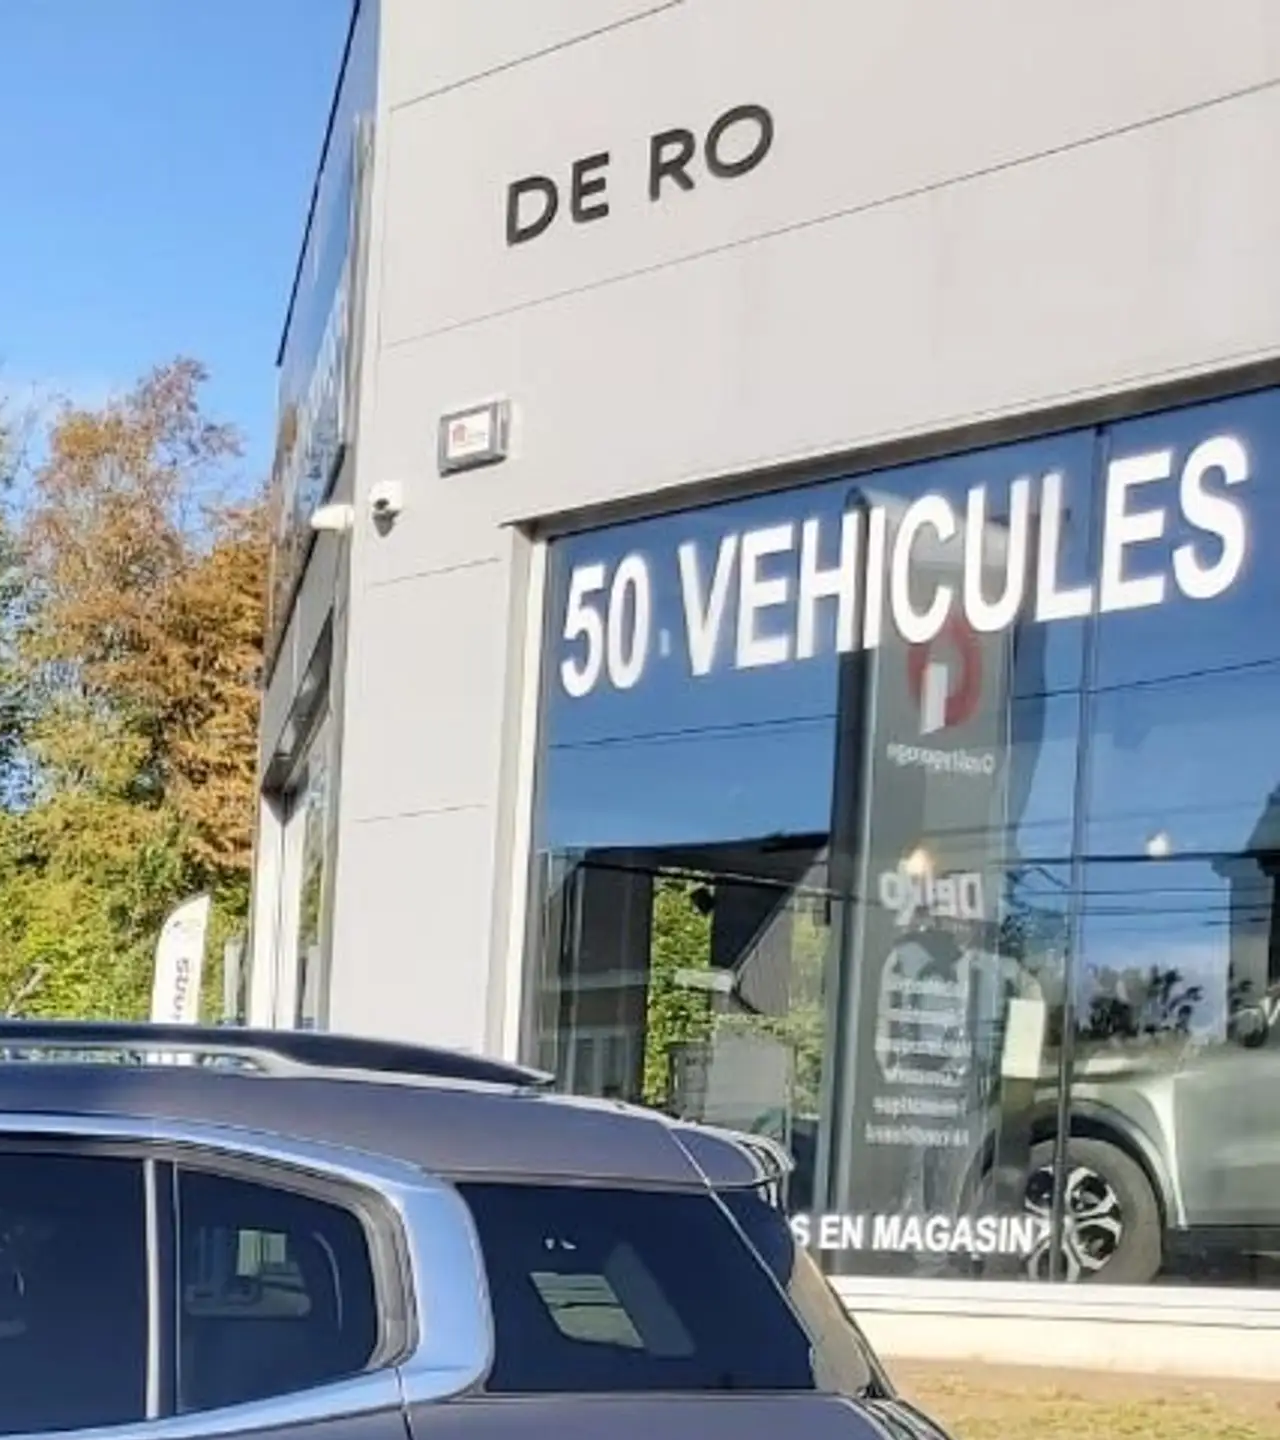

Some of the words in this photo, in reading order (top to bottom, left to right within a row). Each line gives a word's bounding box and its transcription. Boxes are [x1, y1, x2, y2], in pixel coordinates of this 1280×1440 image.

[505, 150, 610, 248] DE
[647, 102, 775, 203] RO
[560, 550, 651, 699] 50
[678, 434, 1251, 678] VEHICULES
[818, 1214, 864, 1250] EN
[871, 1214, 1034, 1254] MAGASIN
